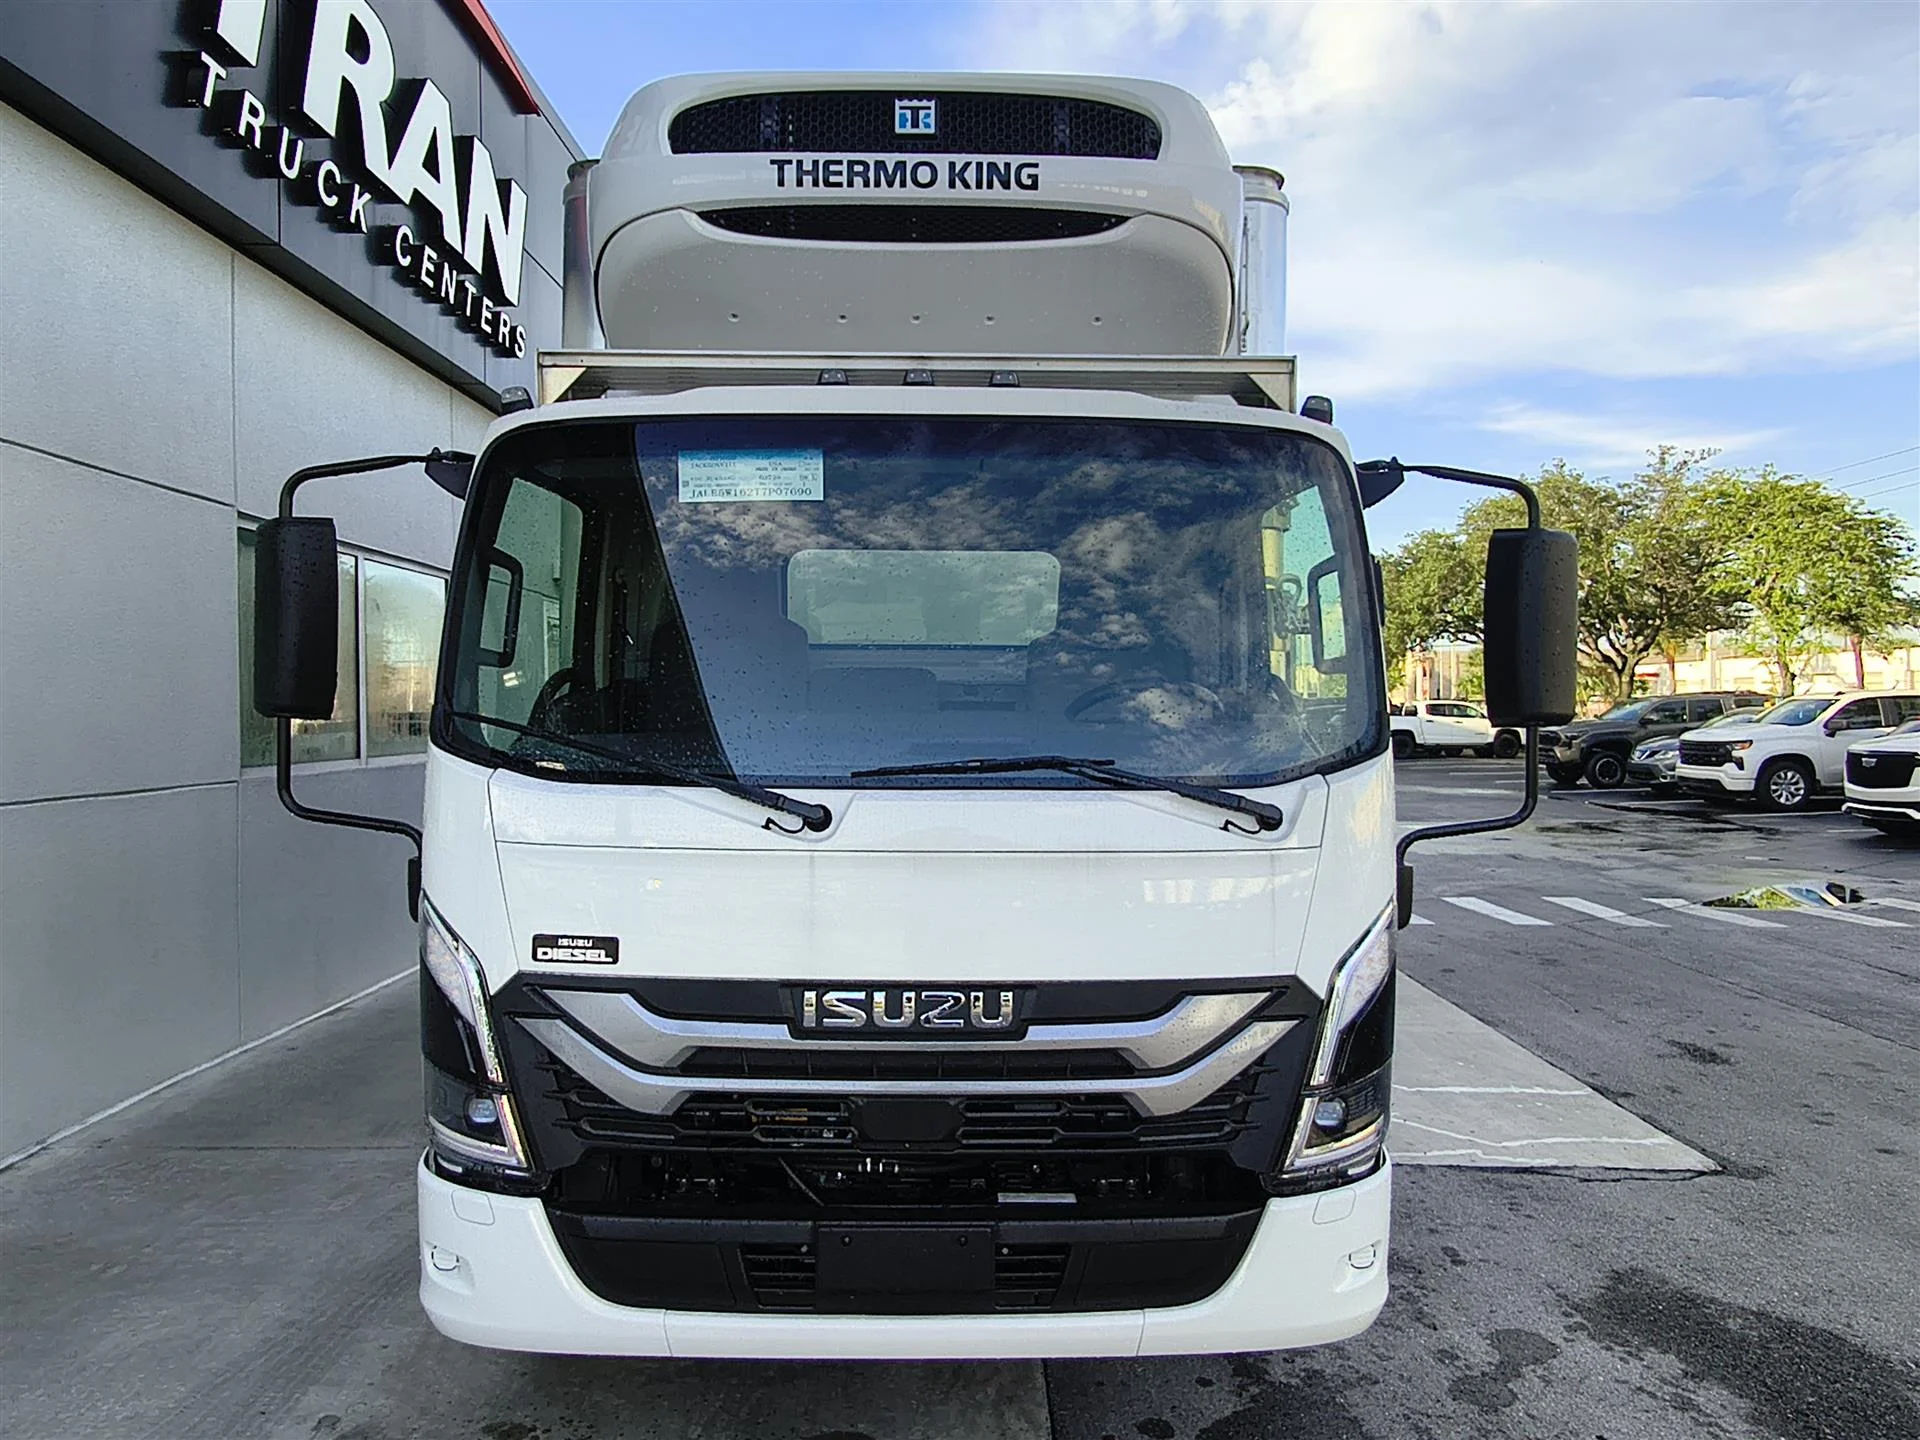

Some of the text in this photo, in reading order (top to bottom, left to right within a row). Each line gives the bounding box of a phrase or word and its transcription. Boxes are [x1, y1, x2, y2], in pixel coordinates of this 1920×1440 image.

[769, 159, 1040, 191] THERMO KING
[201, 52, 527, 359] TRUCK CENTERS
[536, 947, 613, 962] DIESEL
[557, 938, 593, 947] ISUZU
[803, 990, 1013, 1028] ISUZU
